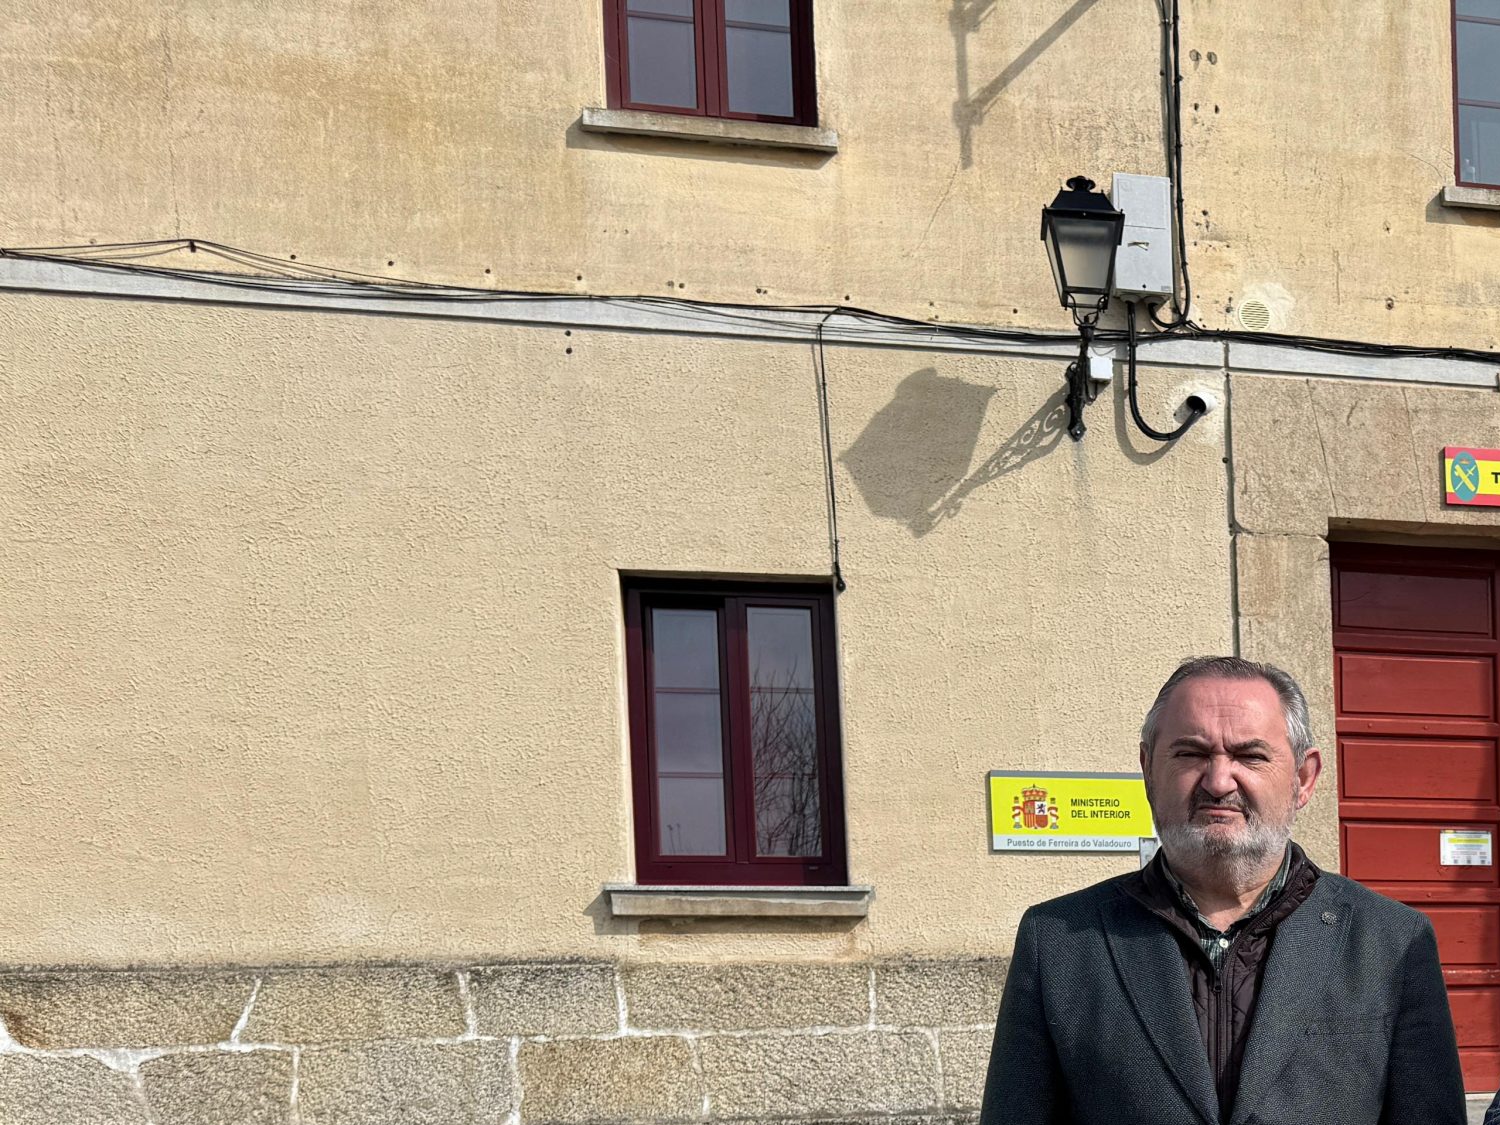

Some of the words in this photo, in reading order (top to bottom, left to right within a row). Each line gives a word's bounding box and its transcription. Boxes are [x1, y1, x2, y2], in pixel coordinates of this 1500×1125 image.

[1070, 798, 1120, 807] MINISTERIO
[1071, 810, 1088, 818] DEL
[1090, 810, 1131, 819] INTERIOR
[1007, 838, 1034, 847] Puesto
[1036, 839, 1046, 848] de
[1048, 839, 1078, 848] Ferreira
[1081, 840, 1091, 848] do
[1093, 840, 1132, 848] Valadouro
